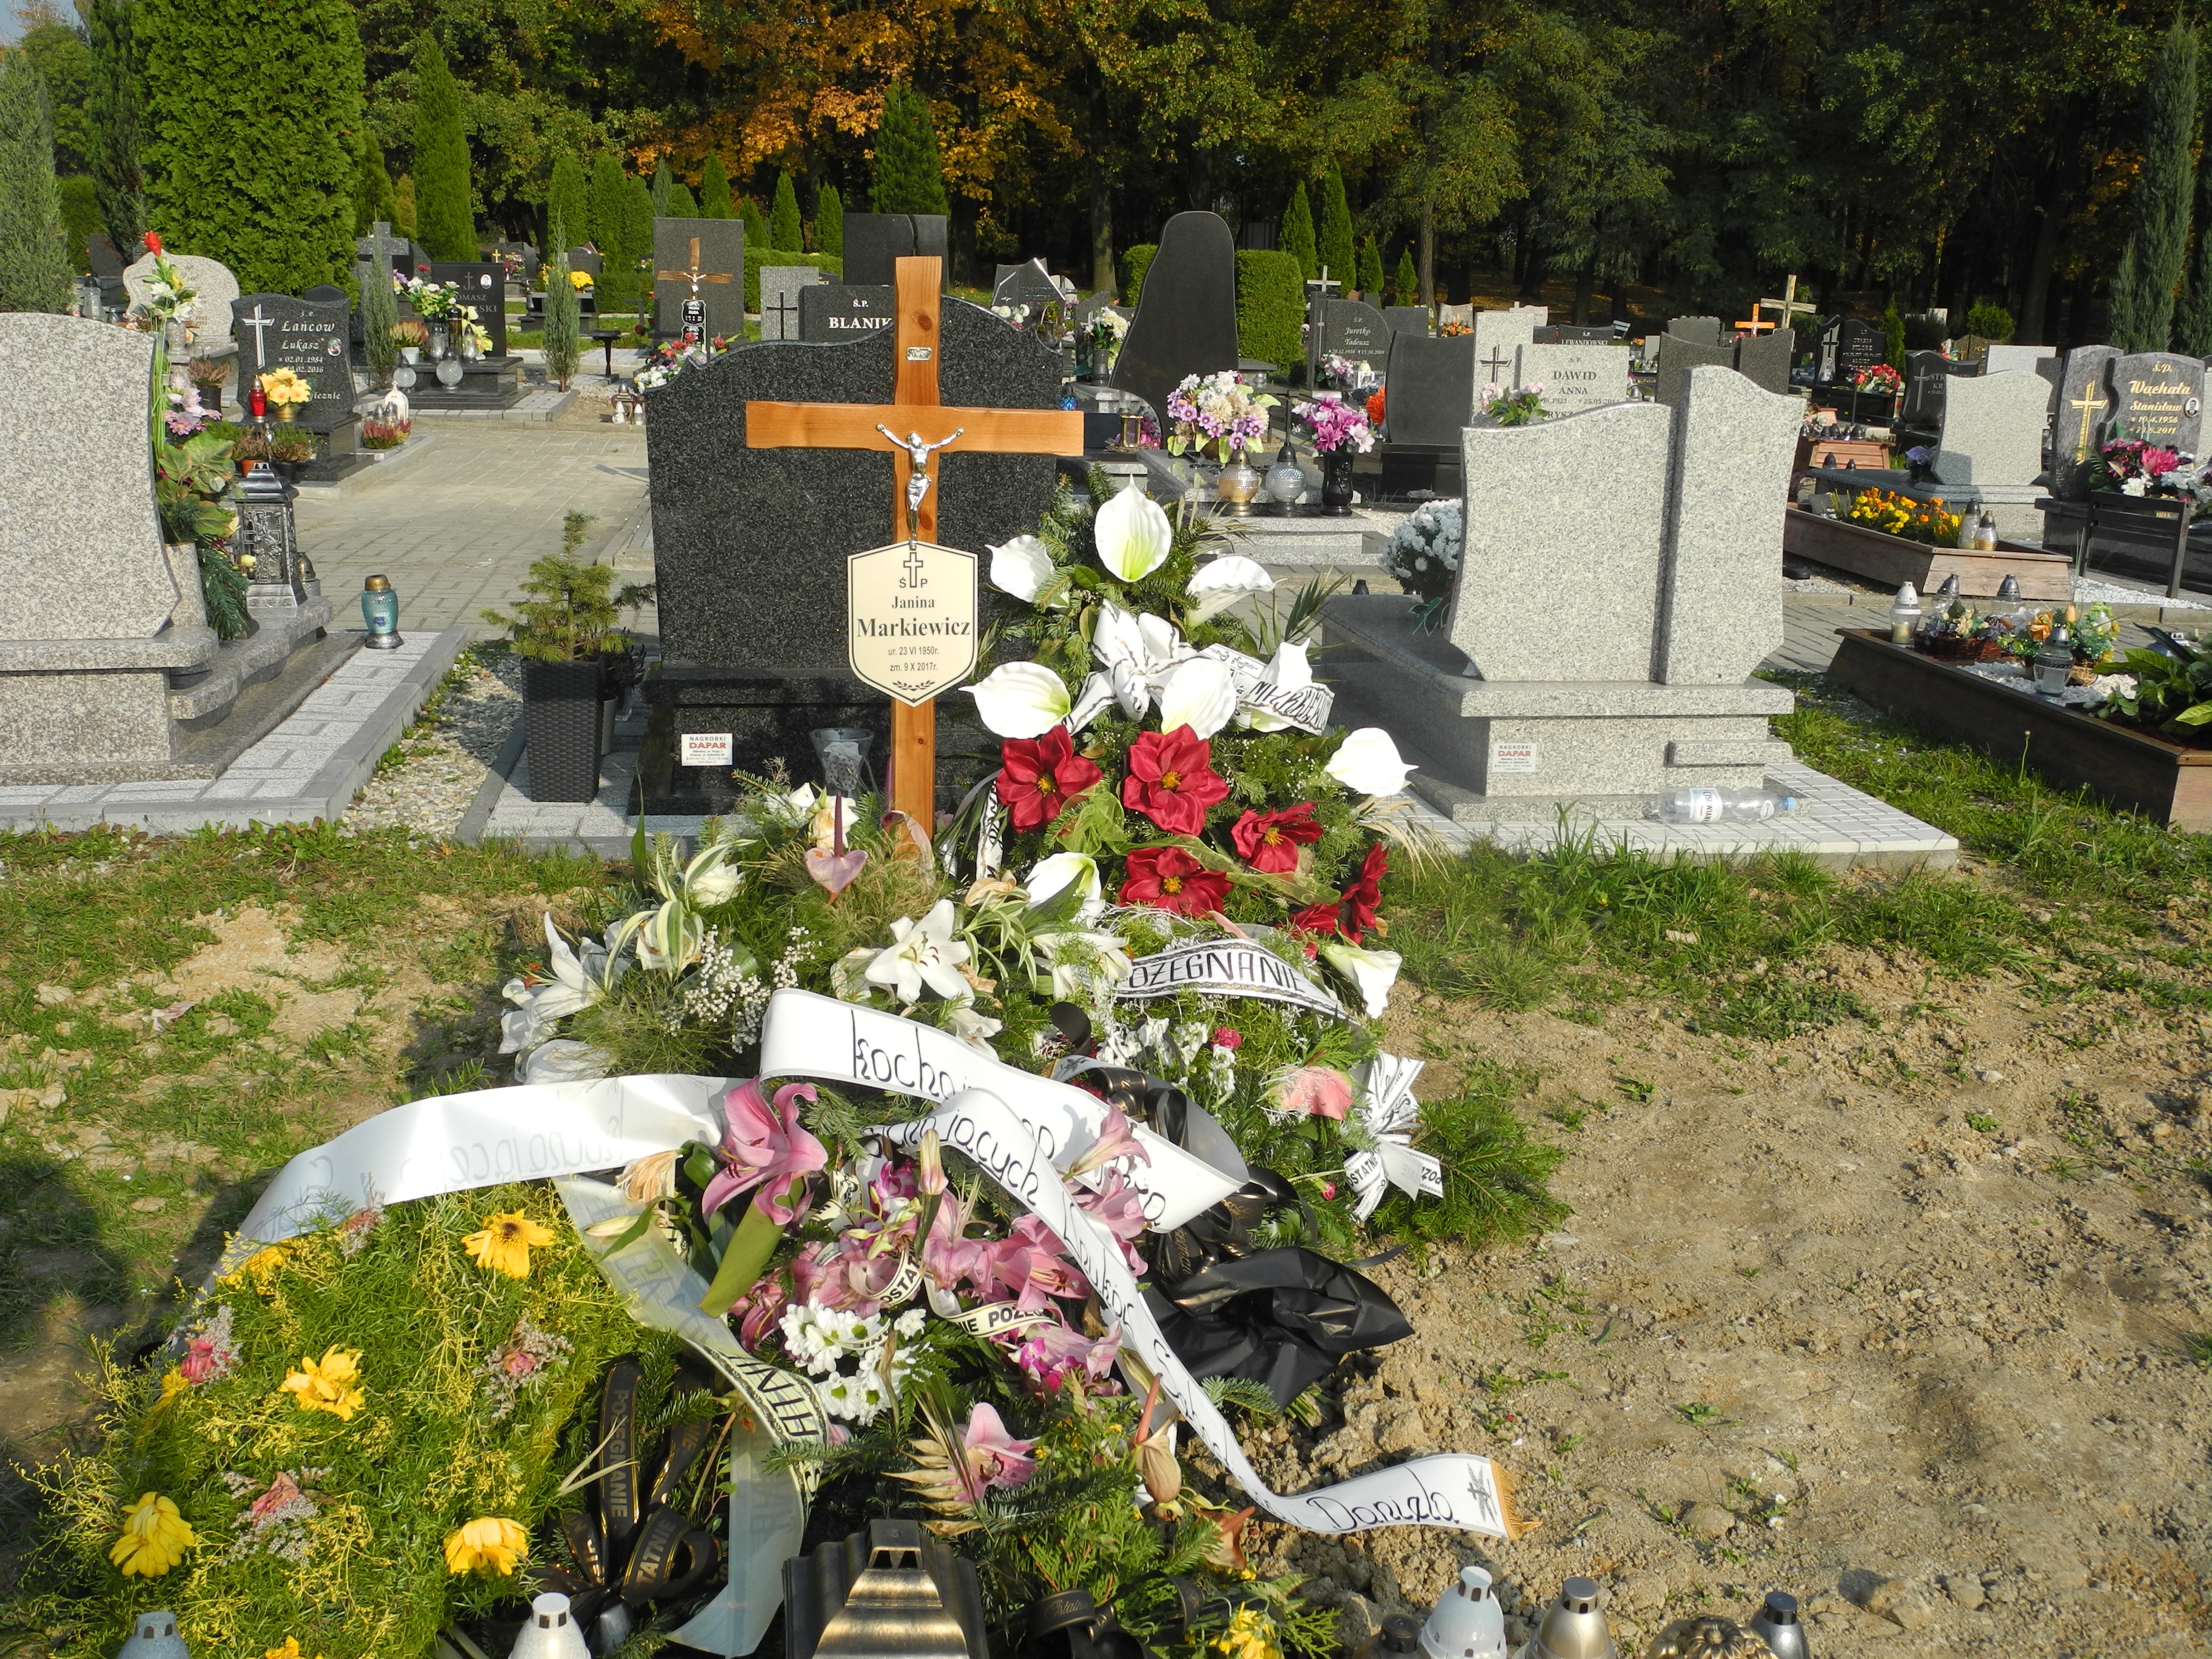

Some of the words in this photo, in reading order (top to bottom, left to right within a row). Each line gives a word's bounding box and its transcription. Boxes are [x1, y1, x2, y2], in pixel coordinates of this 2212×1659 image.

[828, 317, 893, 329] BLANIK
[1553, 370, 1597, 380] DAWID
[920, 578, 928, 588] P
[892, 596, 935, 609] Janina
[857, 617, 971, 637] Markiewicz
[899, 647, 908, 655] 23
[910, 646, 916, 655] VI
[919, 646, 939, 655] 1950r.
[904, 663, 908, 671] 9
[917, 662, 938, 671] 2017r.
[1128, 951, 1305, 993] OŻEGNANIE
[635, 1518, 676, 1585] TATNIE
